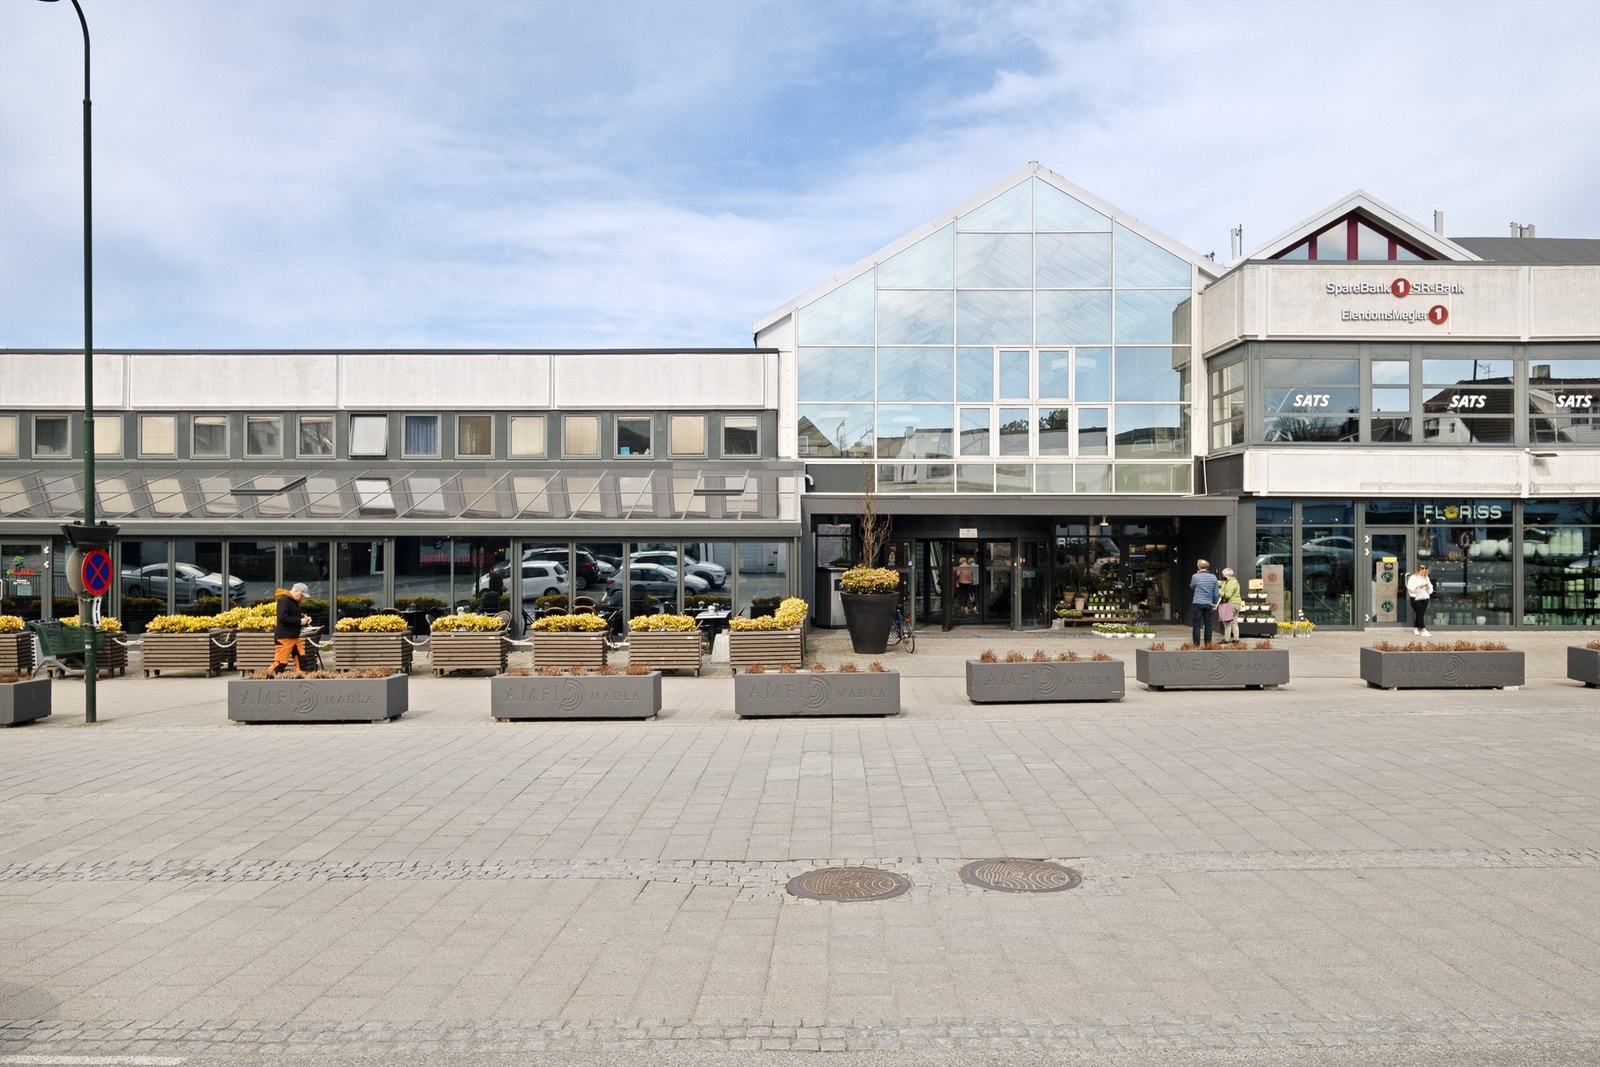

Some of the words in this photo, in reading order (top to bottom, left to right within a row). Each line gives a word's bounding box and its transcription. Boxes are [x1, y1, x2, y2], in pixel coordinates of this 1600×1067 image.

[1326, 283, 1391, 296] SpareBank
[1411, 283, 1464, 295] SR-Bank
[1293, 394, 1331, 407] SATS
[1449, 395, 1487, 408] SATS
[1555, 395, 1593, 408] SATS
[1423, 505, 1502, 519] FLORISS
[748, 681, 804, 700] AMFI
